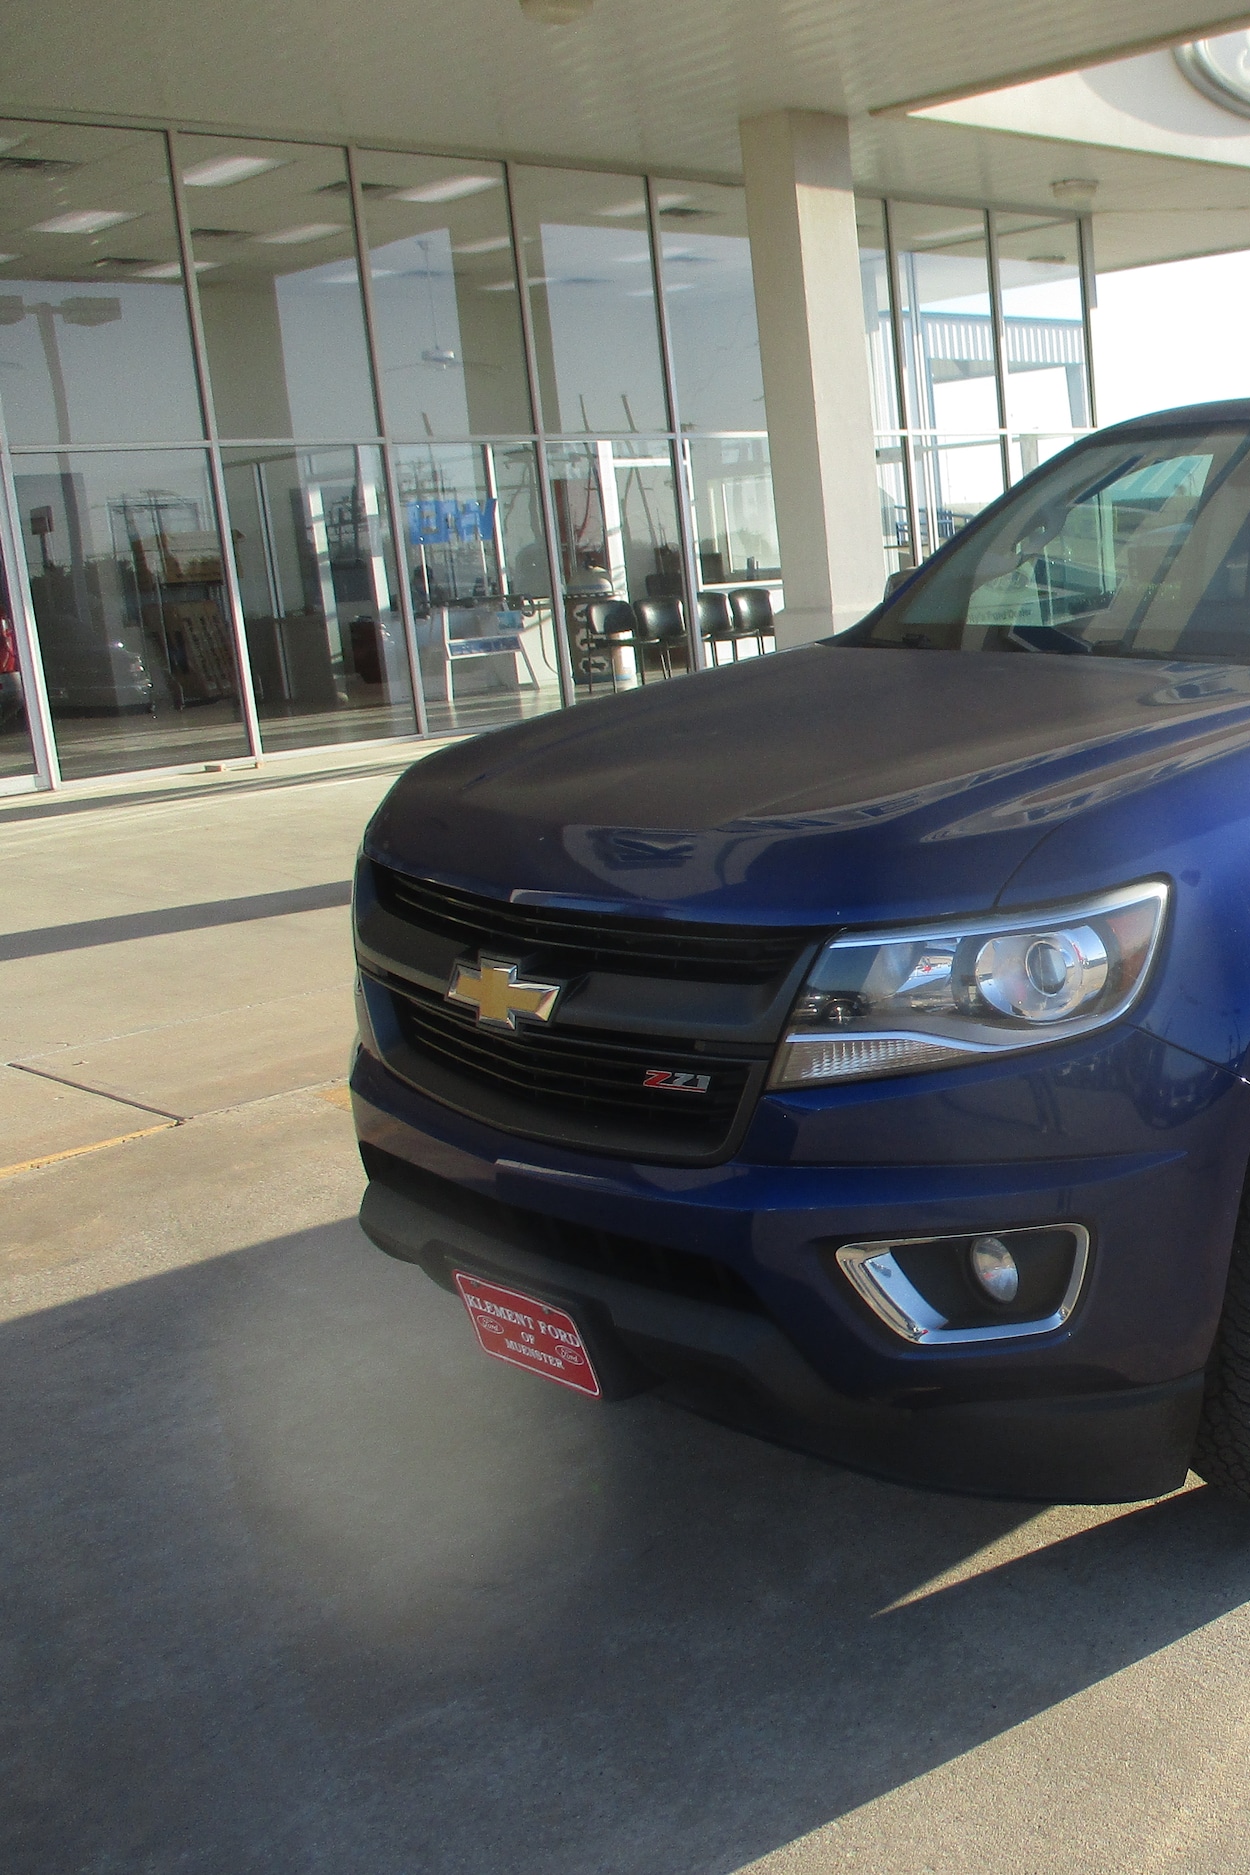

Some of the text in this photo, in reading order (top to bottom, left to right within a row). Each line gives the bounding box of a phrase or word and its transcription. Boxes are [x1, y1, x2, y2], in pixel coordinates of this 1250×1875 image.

[643, 1070, 711, 1093] Z71
[466, 1294, 581, 1348] KLEMENT FORD
[480, 1316, 501, 1333] Ford
[521, 1331, 535, 1344] OF
[505, 1339, 565, 1369] MUENSTER
[558, 1346, 580, 1364] Ford
